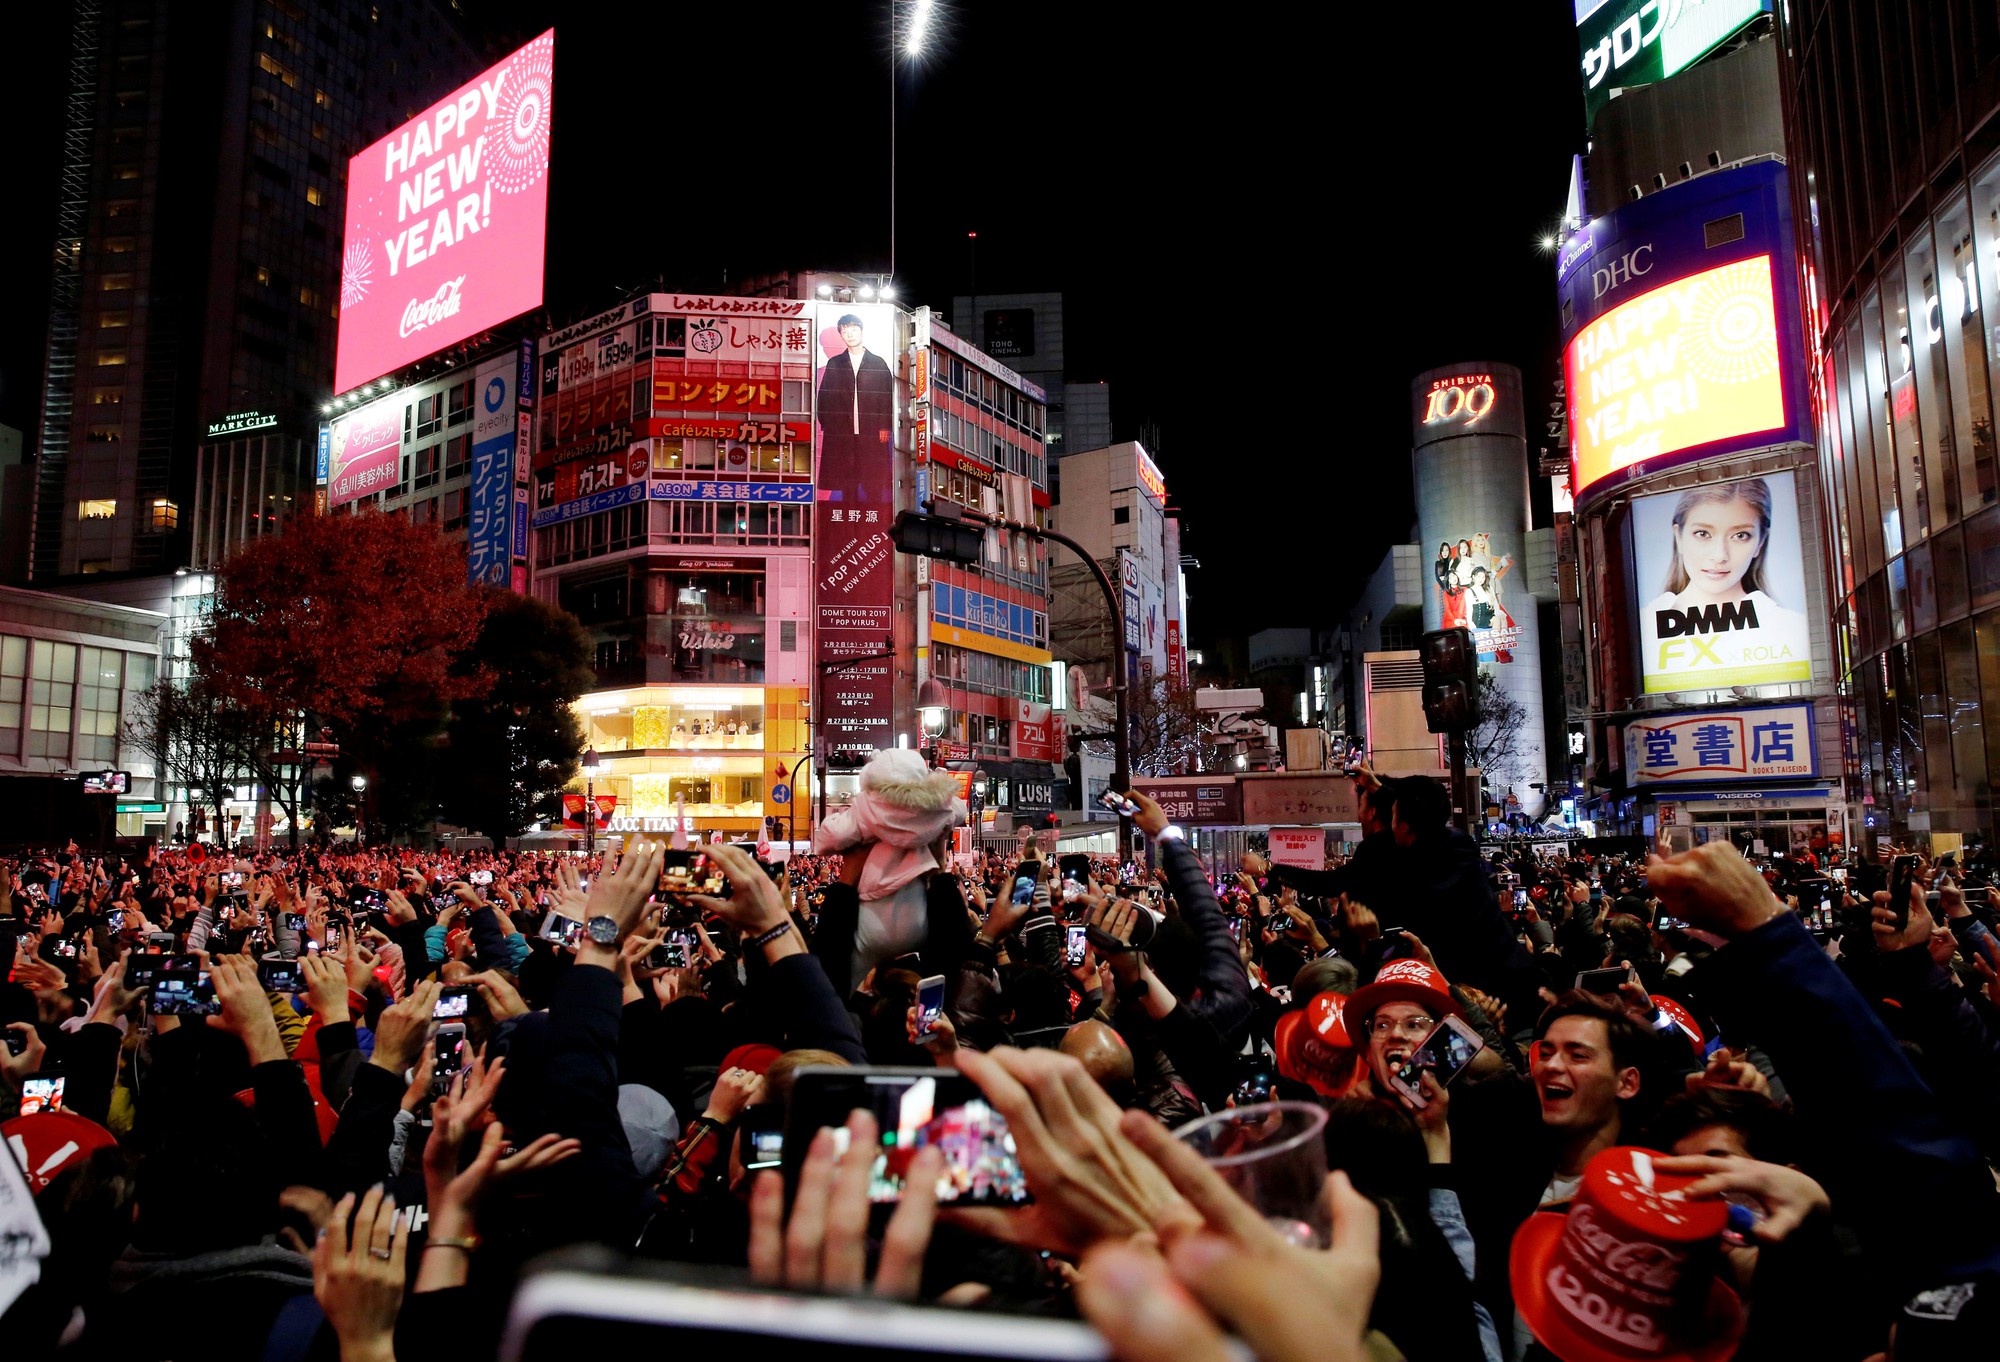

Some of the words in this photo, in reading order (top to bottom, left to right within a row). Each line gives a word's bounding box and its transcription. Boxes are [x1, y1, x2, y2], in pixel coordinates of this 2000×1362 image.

[1582, 0, 1682, 90] サロン
[384, 69, 508, 182] HAPPY
[398, 135, 485, 223] NEW
[384, 181, 491, 277] YEAR!
[1566, 235, 1593, 267] Channel
[1592, 243, 1654, 300] DHC
[399, 274, 466, 338] Coca-Cola
[673, 296, 805, 316] しゃぶしゃぶバイキング
[730, 325, 808, 351] しゃぶ葉
[1577, 281, 1708, 372] HAPPY
[990, 347, 1021, 355] CINEMAS
[545, 366, 558, 383] 9F
[1590, 333, 1681, 405] NEW
[655, 381, 777, 405] コンタクト
[1433, 375, 1492, 389] SHIBUYA
[225, 411, 259, 421] SHIBUYA
[1422, 383, 1495, 426] 109
[1585, 371, 1699, 448] YEAR!
[208, 421, 244, 433] MARK
[246, 415, 276, 427] CITY
[477, 413, 510, 433] eyecity
[739, 421, 796, 444] ガスト
[362, 426, 395, 448] クリニック
[597, 426, 632, 453] ガスト
[918, 431, 926, 458] ガスト
[339, 460, 396, 496] 品川美容外科
[540, 481, 555, 500] 7F
[579, 461, 623, 496] ガスト
[655, 483, 692, 497] AEON
[701, 482, 810, 500] 英会話イーオン
[561, 490, 627, 519] 英会話イーオン
[831, 509, 879, 523] 星野源
[472, 452, 494, 583] アイシティ
[830, 552, 842, 565] NEW
[841, 538, 858, 555] ALBUM
[842, 575, 860, 594] NOW
[858, 567, 870, 578] ON
[868, 548, 889, 569] SALE!
[1125, 560, 1138, 588] OS
[822, 609, 844, 617] DOME
[1656, 599, 1760, 639] DMM
[1490, 626, 1523, 638] SALE
[1494, 635, 1516, 645] SUN
[1478, 646, 1496, 654] NEW
[1496, 642, 1518, 650] YEAR
[1658, 635, 1723, 670] FX
[1743, 645, 1793, 662] ROLA
[1023, 725, 1046, 742] アコム
[1752, 766, 1775, 775] BOOKS
[1777, 765, 1808, 774] TAISEIDO
[1018, 784, 1052, 803] LUSH
[1160, 790, 1188, 798] 東急電鉄
[1714, 792, 1762, 800] TAISEIDO
[1157, 801, 1194, 818] 谷駅
